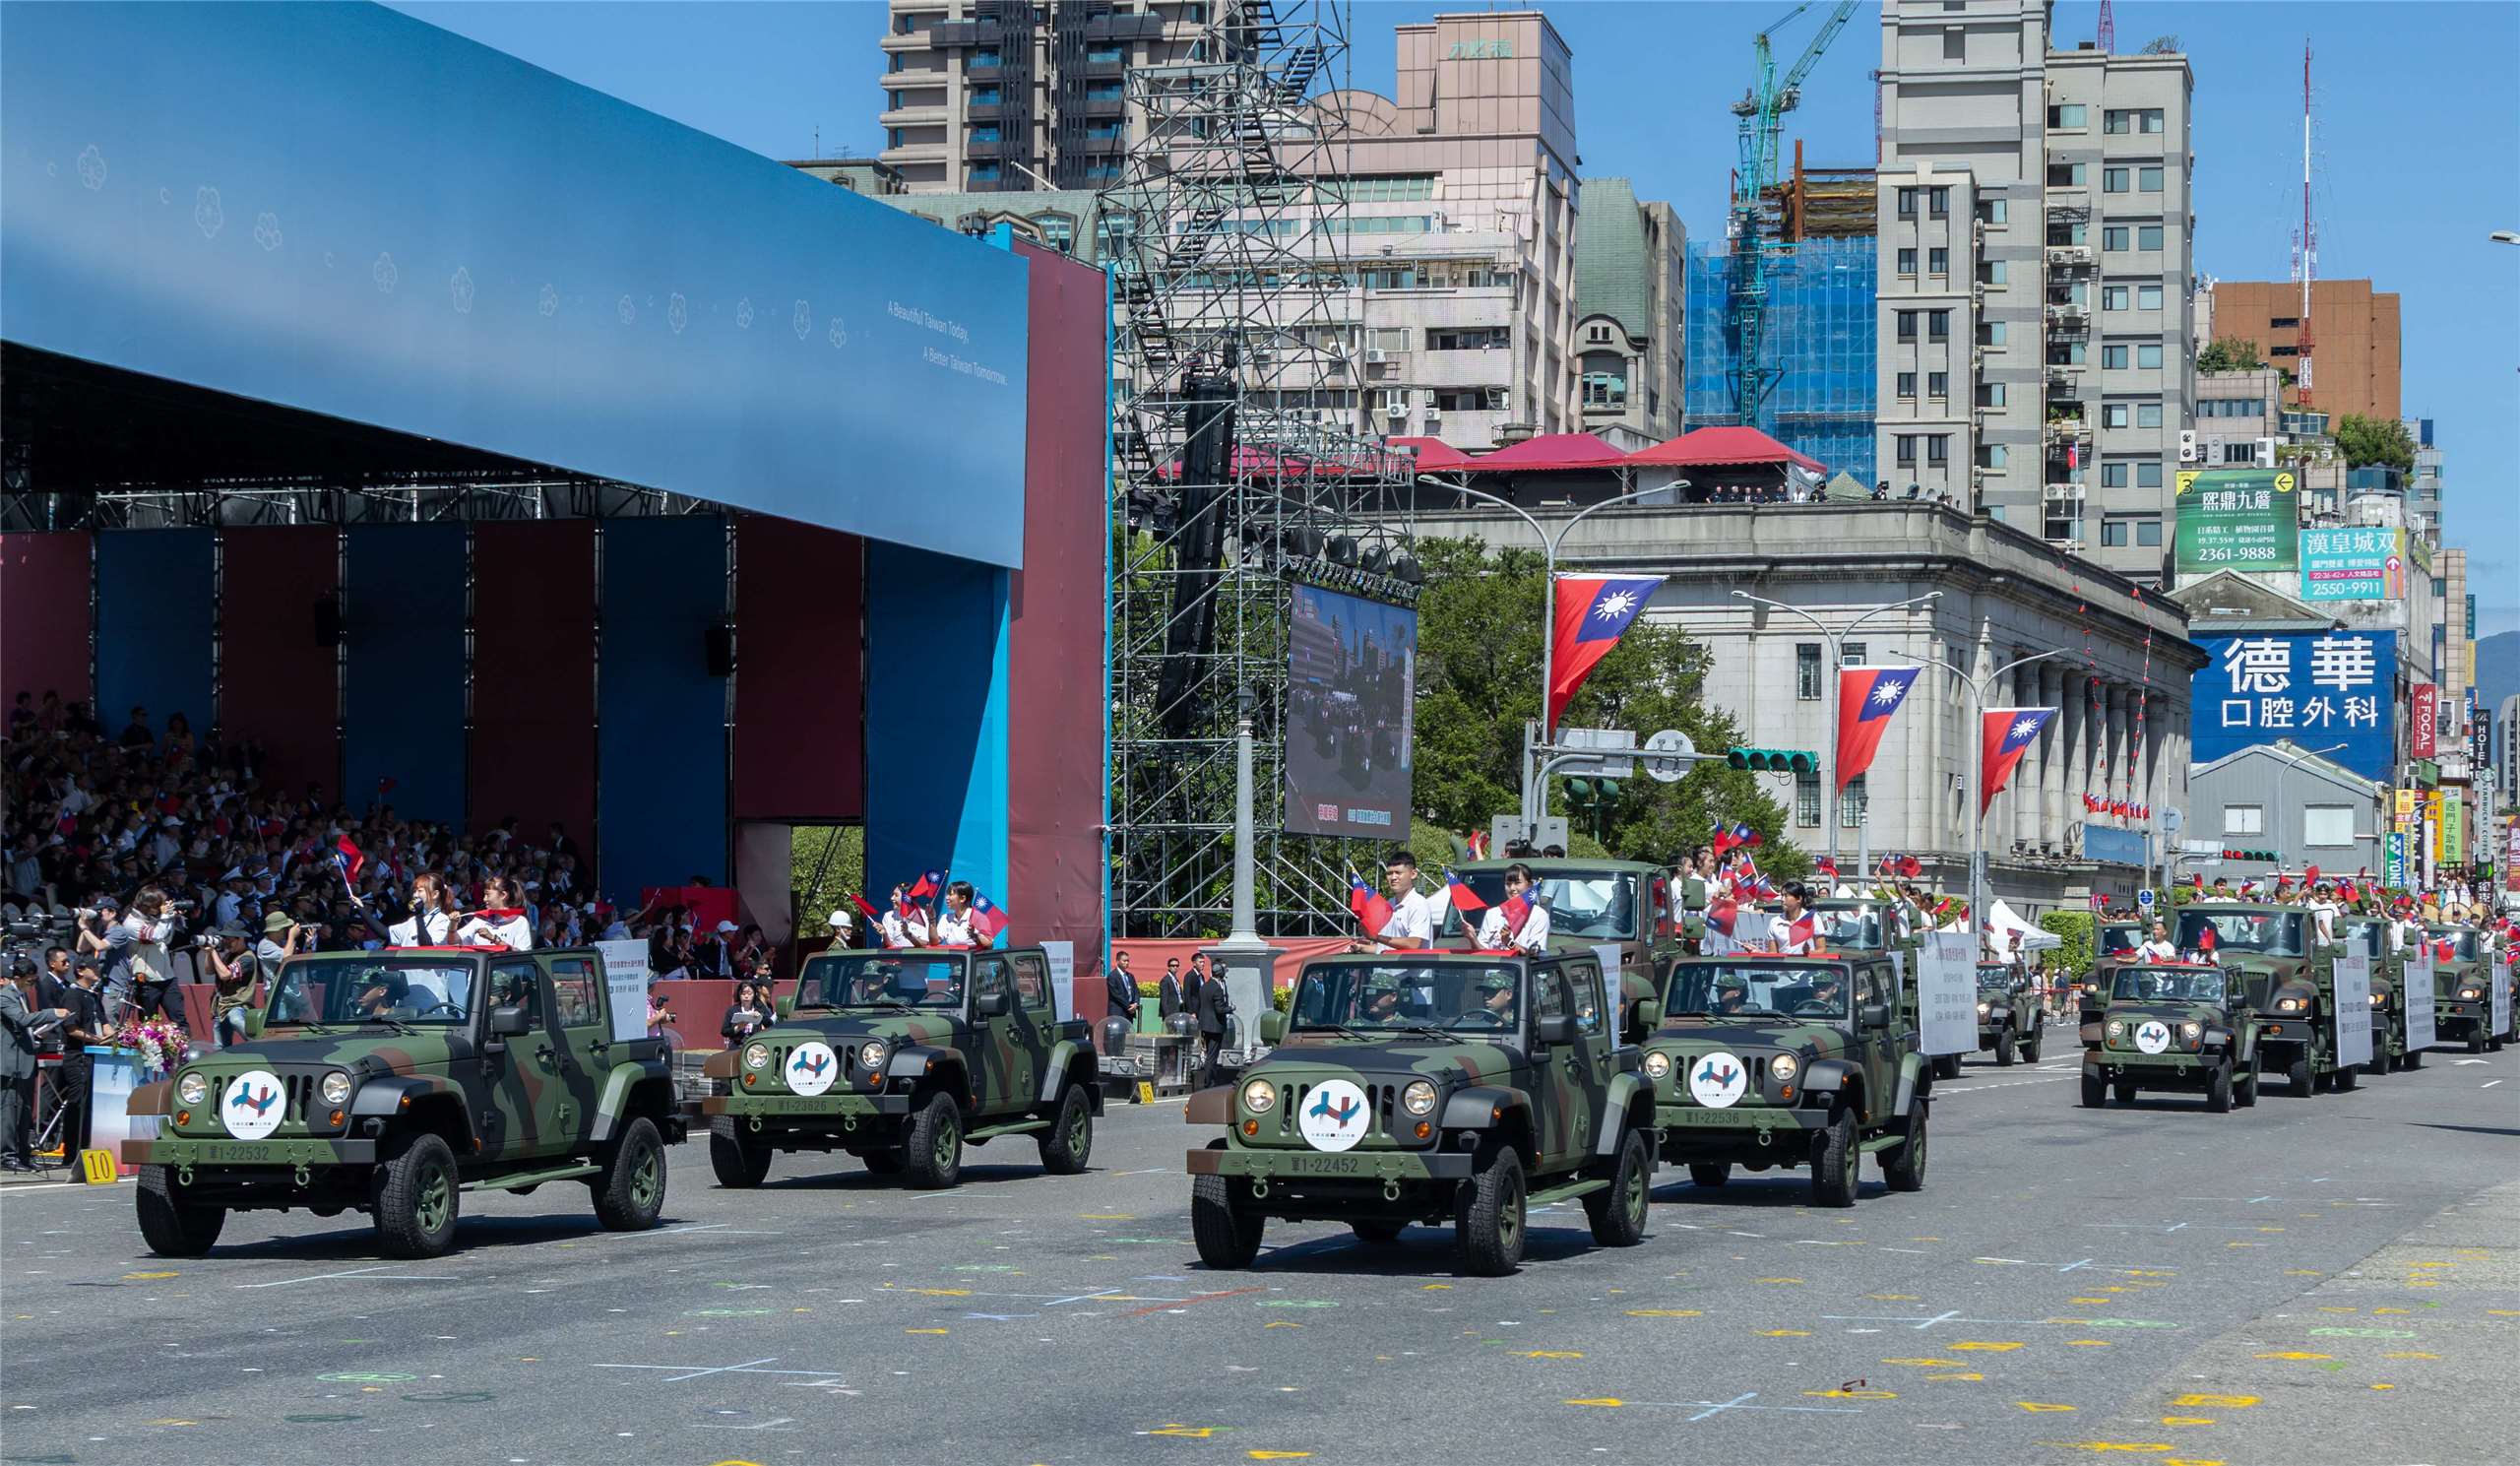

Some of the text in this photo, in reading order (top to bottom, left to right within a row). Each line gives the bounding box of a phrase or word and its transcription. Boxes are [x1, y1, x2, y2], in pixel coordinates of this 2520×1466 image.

[894, 302, 923, 326] Beautiful
[924, 312, 947, 334] Taiwan
[949, 321, 970, 344] Today,
[929, 348, 949, 367] Better
[950, 354, 973, 374] Taiwan
[2182, 478, 2193, 494] 3
[2198, 546, 2276, 561] 2361-9888
[2307, 532, 2398, 554] 漢皇城双
[2312, 582, 2380, 595] 2550-9911
[2224, 636, 2376, 694] 德華
[2221, 696, 2379, 729] 口腔外科
[2420, 706, 2431, 750] FOCAL
[2478, 726, 2487, 769] HOTEL
[89, 1153, 111, 1179] 10
